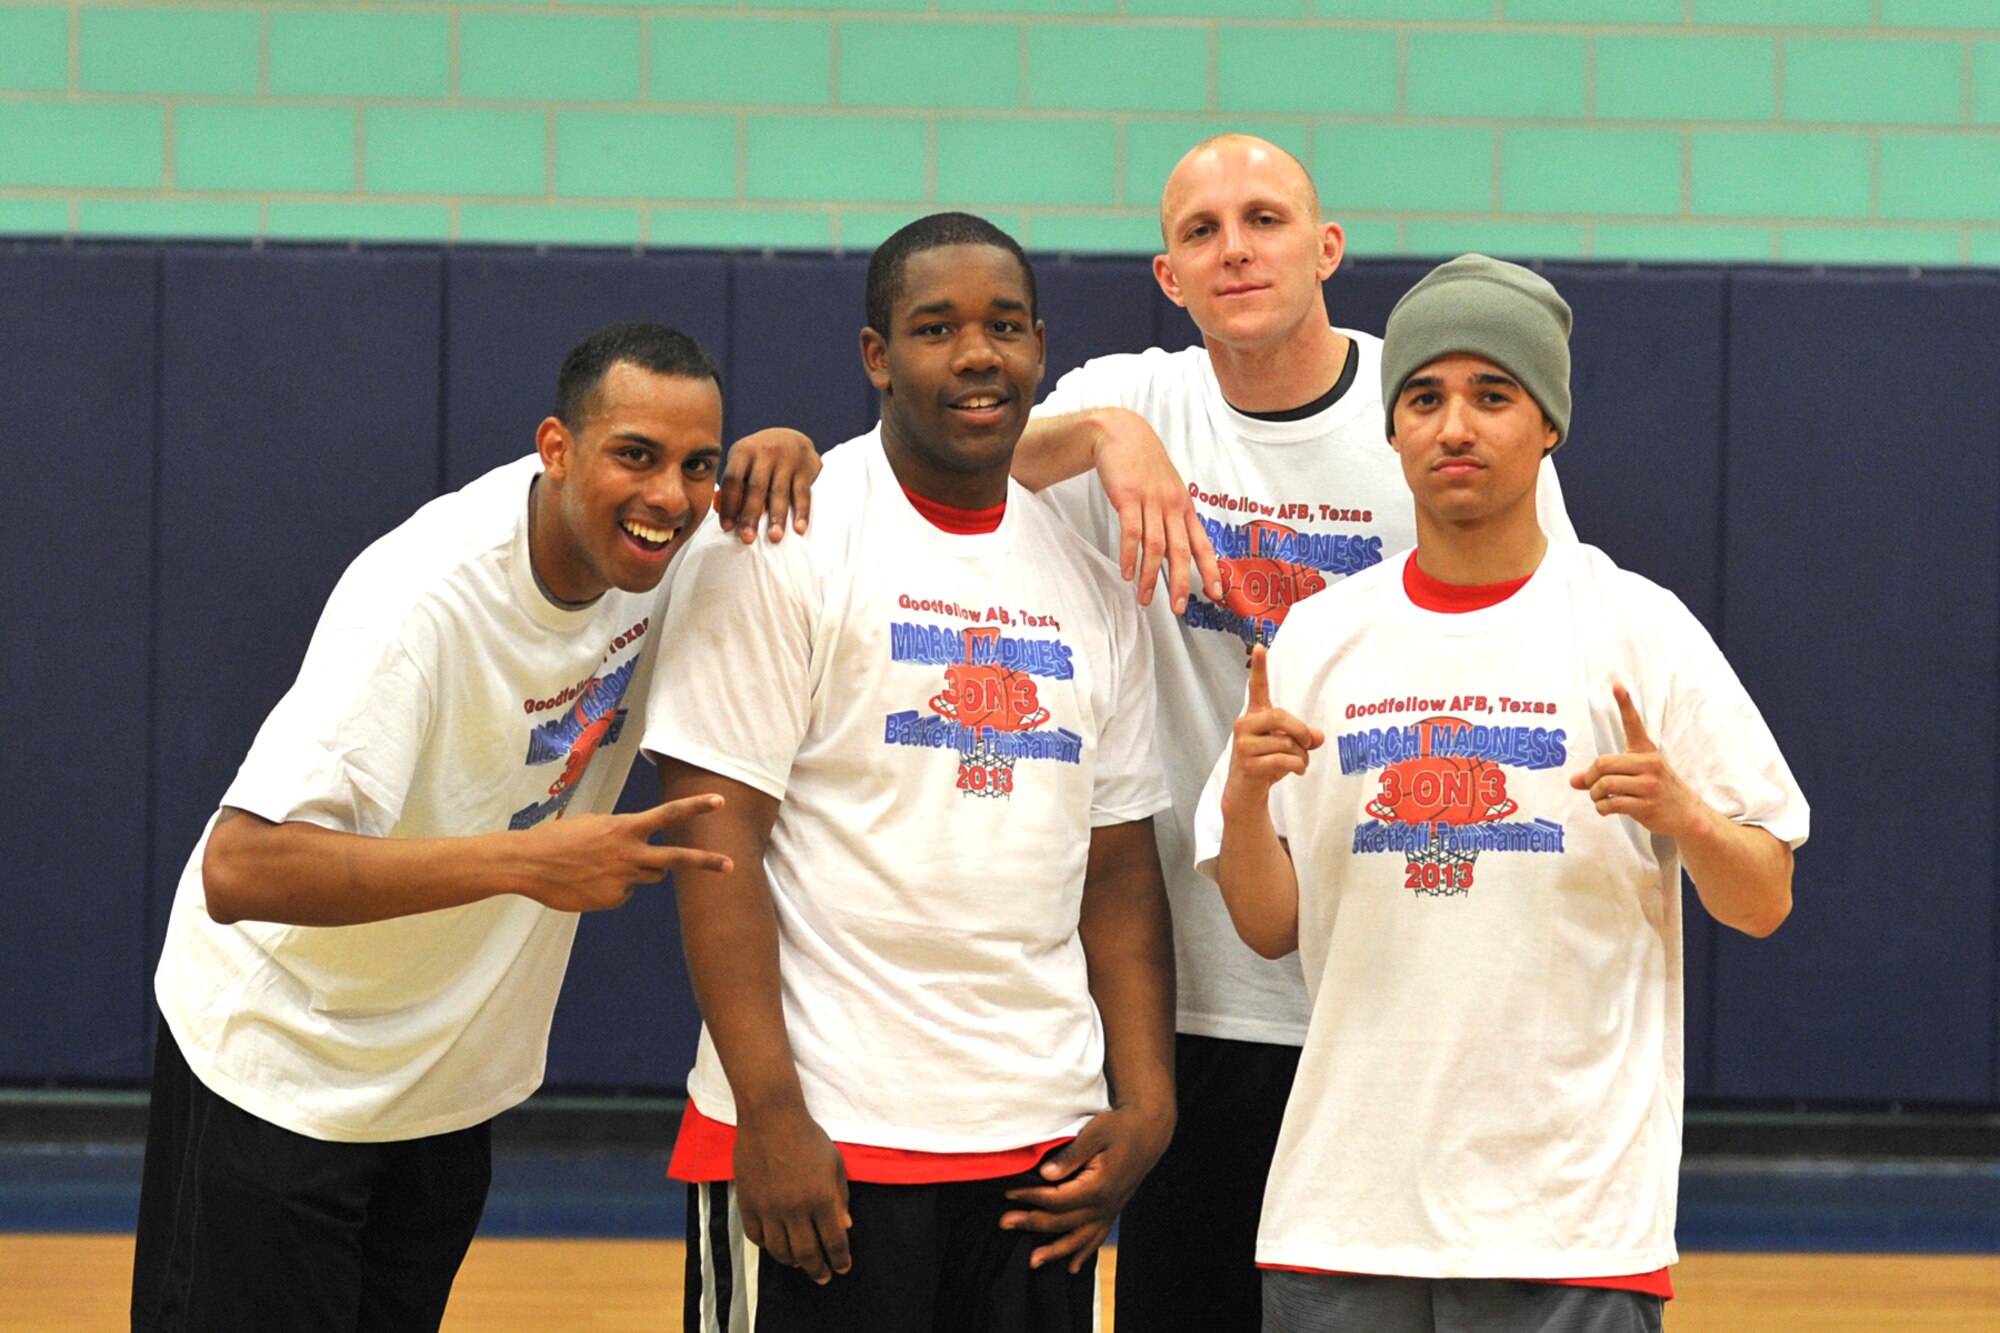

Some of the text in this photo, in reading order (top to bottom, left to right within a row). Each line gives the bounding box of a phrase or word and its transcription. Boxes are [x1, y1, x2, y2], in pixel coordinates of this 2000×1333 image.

[1188, 482, 1373, 523] Goofellow AFB, Texas
[1197, 512, 1383, 577] RCH MADNESS
[1241, 570, 1293, 607] ON
[898, 594, 981, 623] Goodfellow
[985, 606, 1017, 627] AB,
[891, 622, 966, 666] MARCH
[524, 676, 596, 714] Goodfell
[942, 669, 1039, 715] 3 ON 3
[1345, 696, 1557, 719] Goodfellow AFB, Texas
[1337, 724, 1567, 775] MARCH MADNESS
[956, 765, 1013, 793] 2013
[1377, 768, 1507, 808] 3 ON 3
[1352, 818, 1565, 854] sketball Tournament
[1404, 863, 1473, 889] 2013
